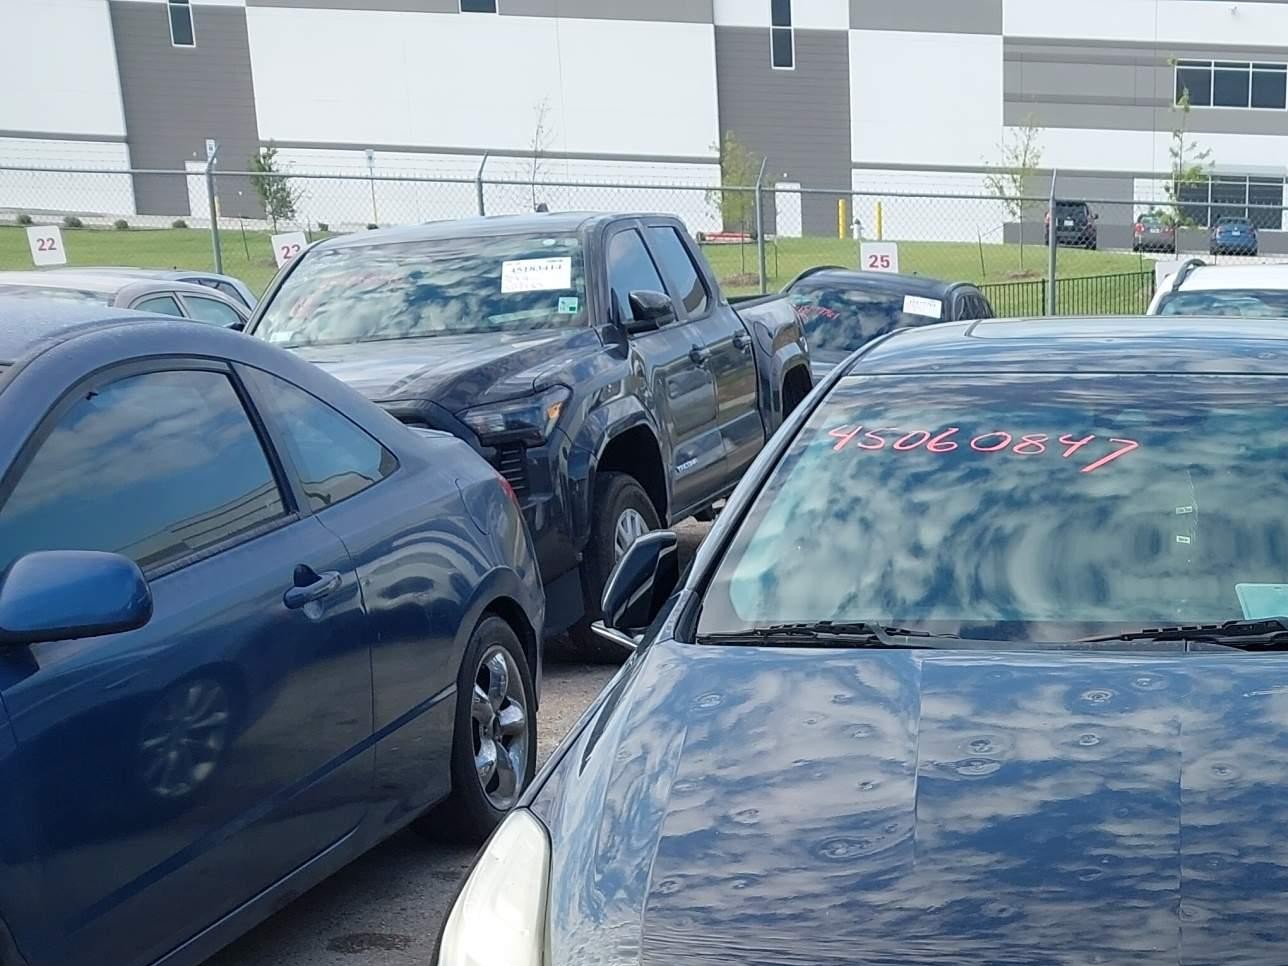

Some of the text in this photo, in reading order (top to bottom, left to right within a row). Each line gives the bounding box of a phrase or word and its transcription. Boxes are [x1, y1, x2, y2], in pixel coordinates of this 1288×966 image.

[36, 238, 57, 251] 22
[869, 254, 890, 268] 25
[828, 424, 1140, 473] 45060847
